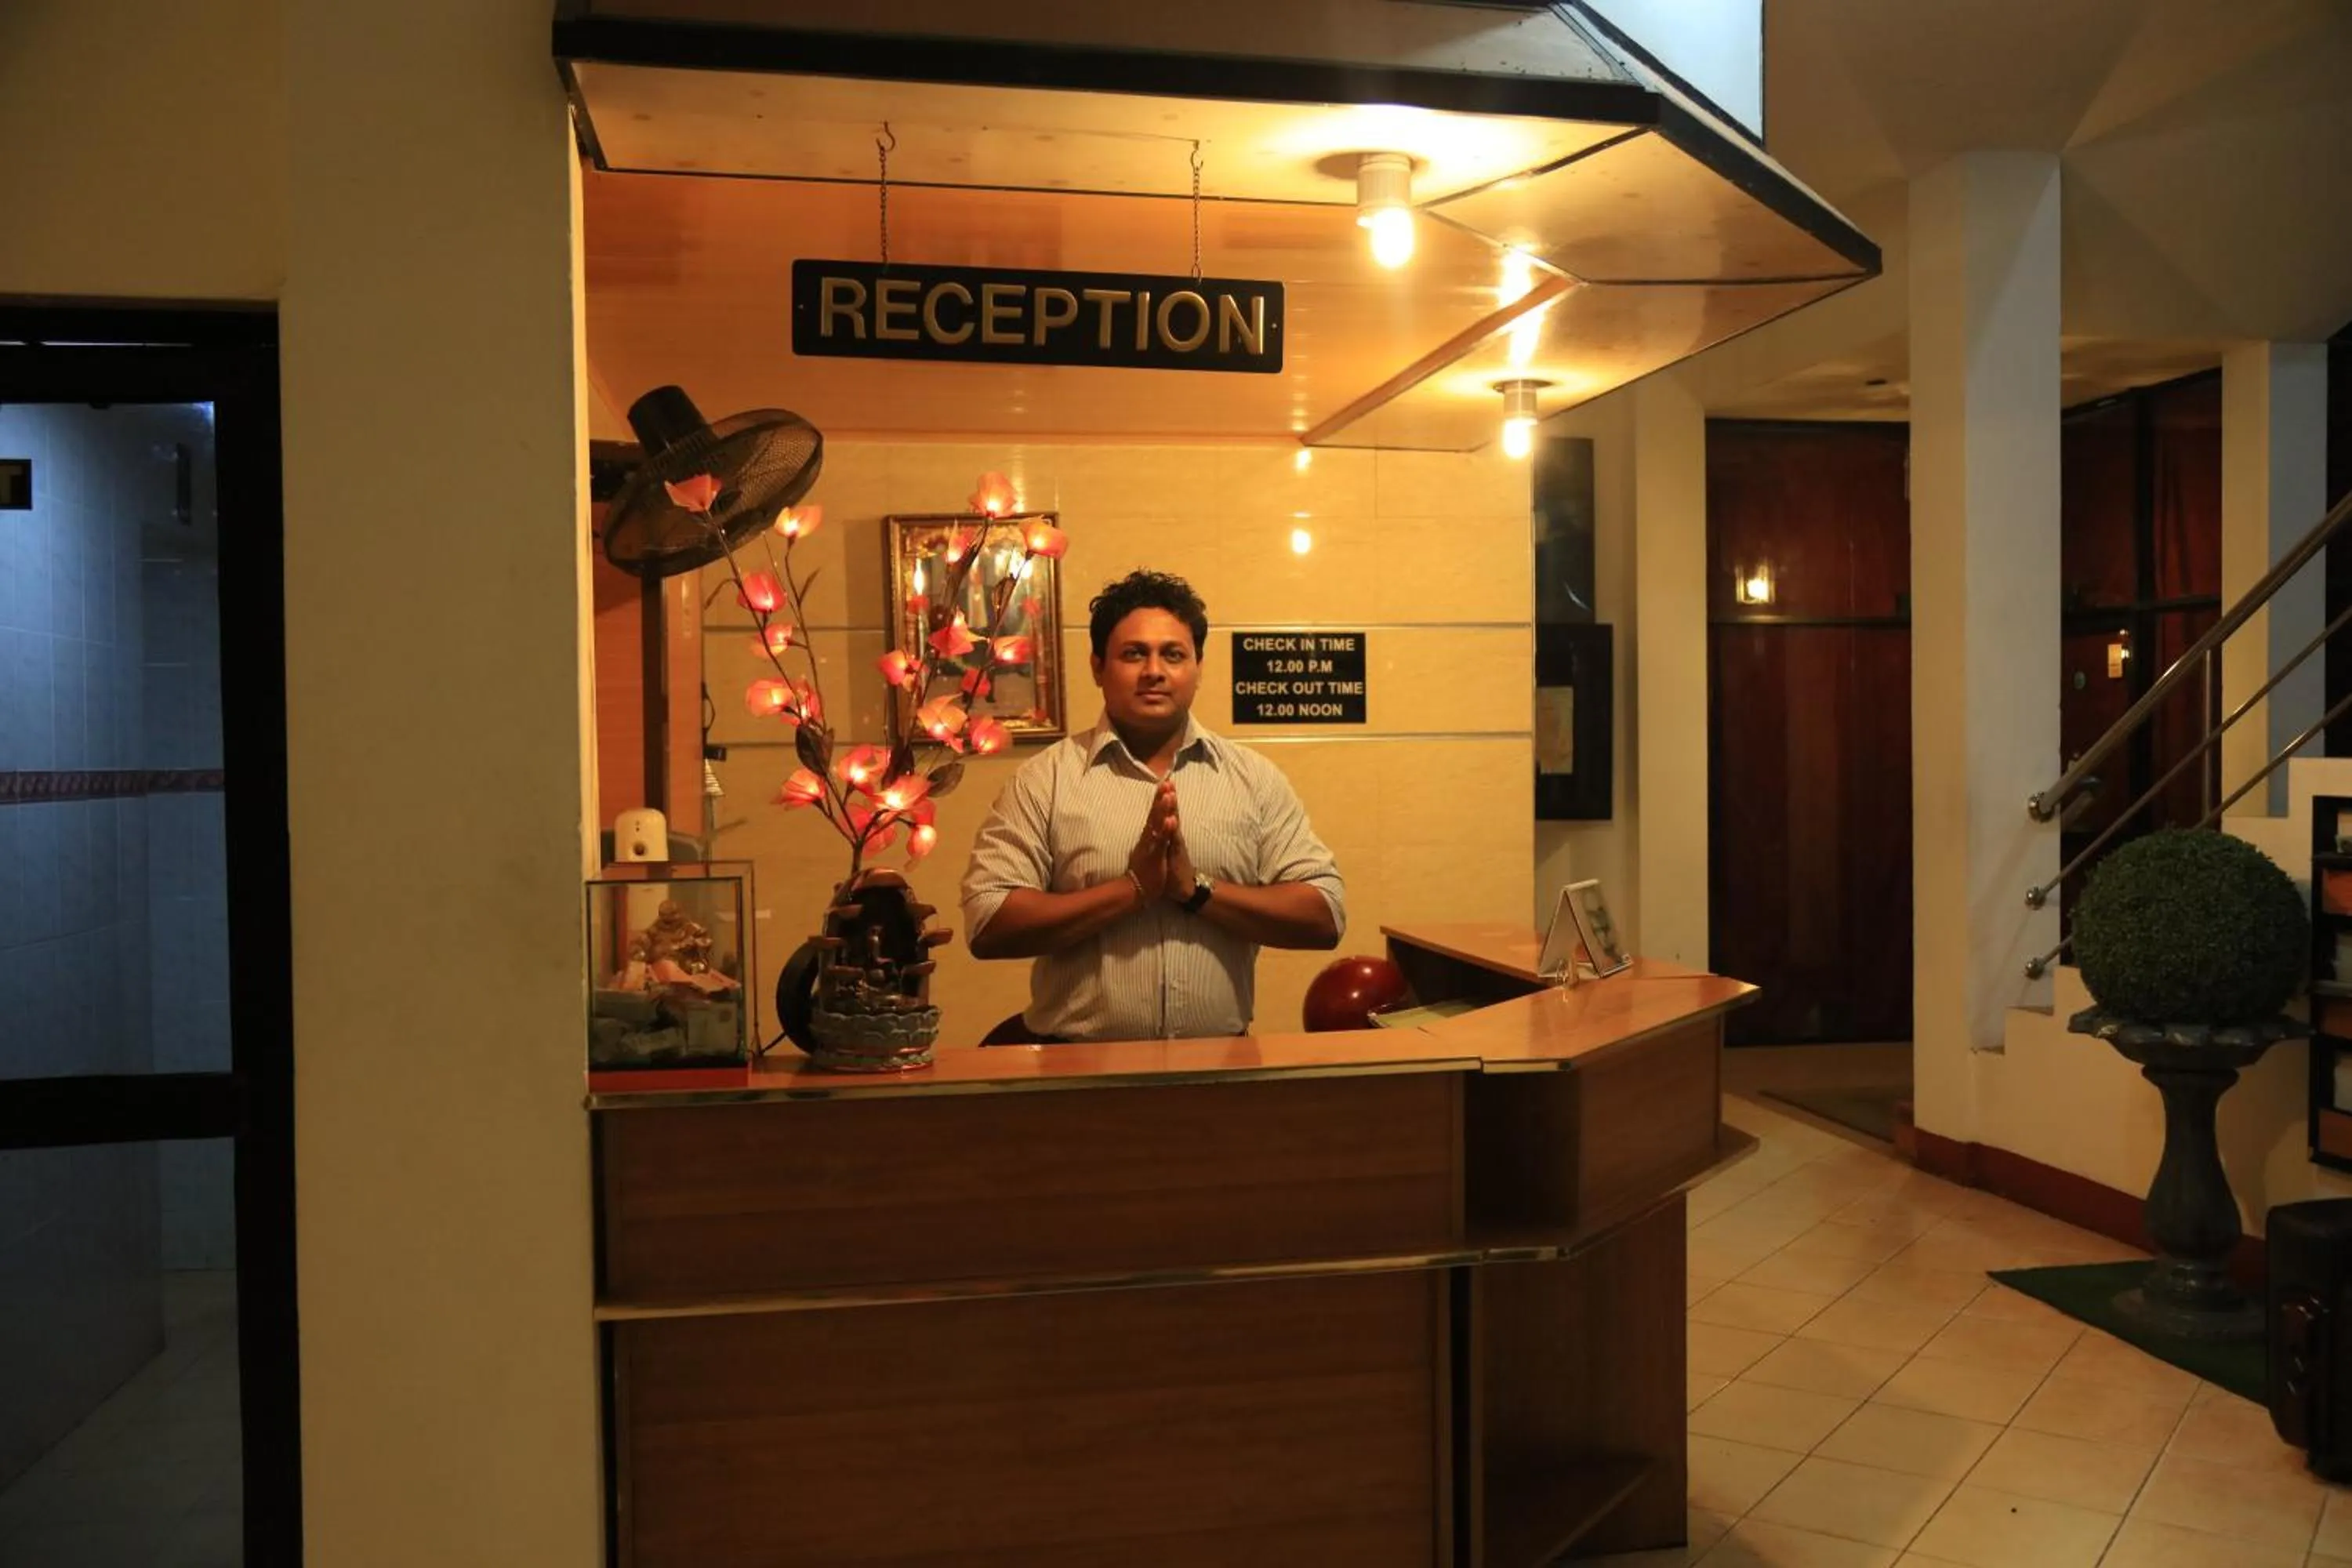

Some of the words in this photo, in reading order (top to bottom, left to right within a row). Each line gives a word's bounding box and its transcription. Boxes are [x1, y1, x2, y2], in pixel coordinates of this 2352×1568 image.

[820, 276, 1265, 355] RECEPTION
[1243, 637, 1296, 652] CHECK
[1301, 638, 1315, 652] IN
[1320, 638, 1355, 652] TIME
[1267, 660, 1304, 673] 12.00
[1308, 660, 1333, 673] P.M
[1235, 681, 1289, 695] CHECK
[1293, 681, 1323, 695] OUT
[1329, 682, 1363, 695] TIME
[1257, 703, 1294, 717] 12.00
[1299, 703, 1343, 717] NOON
